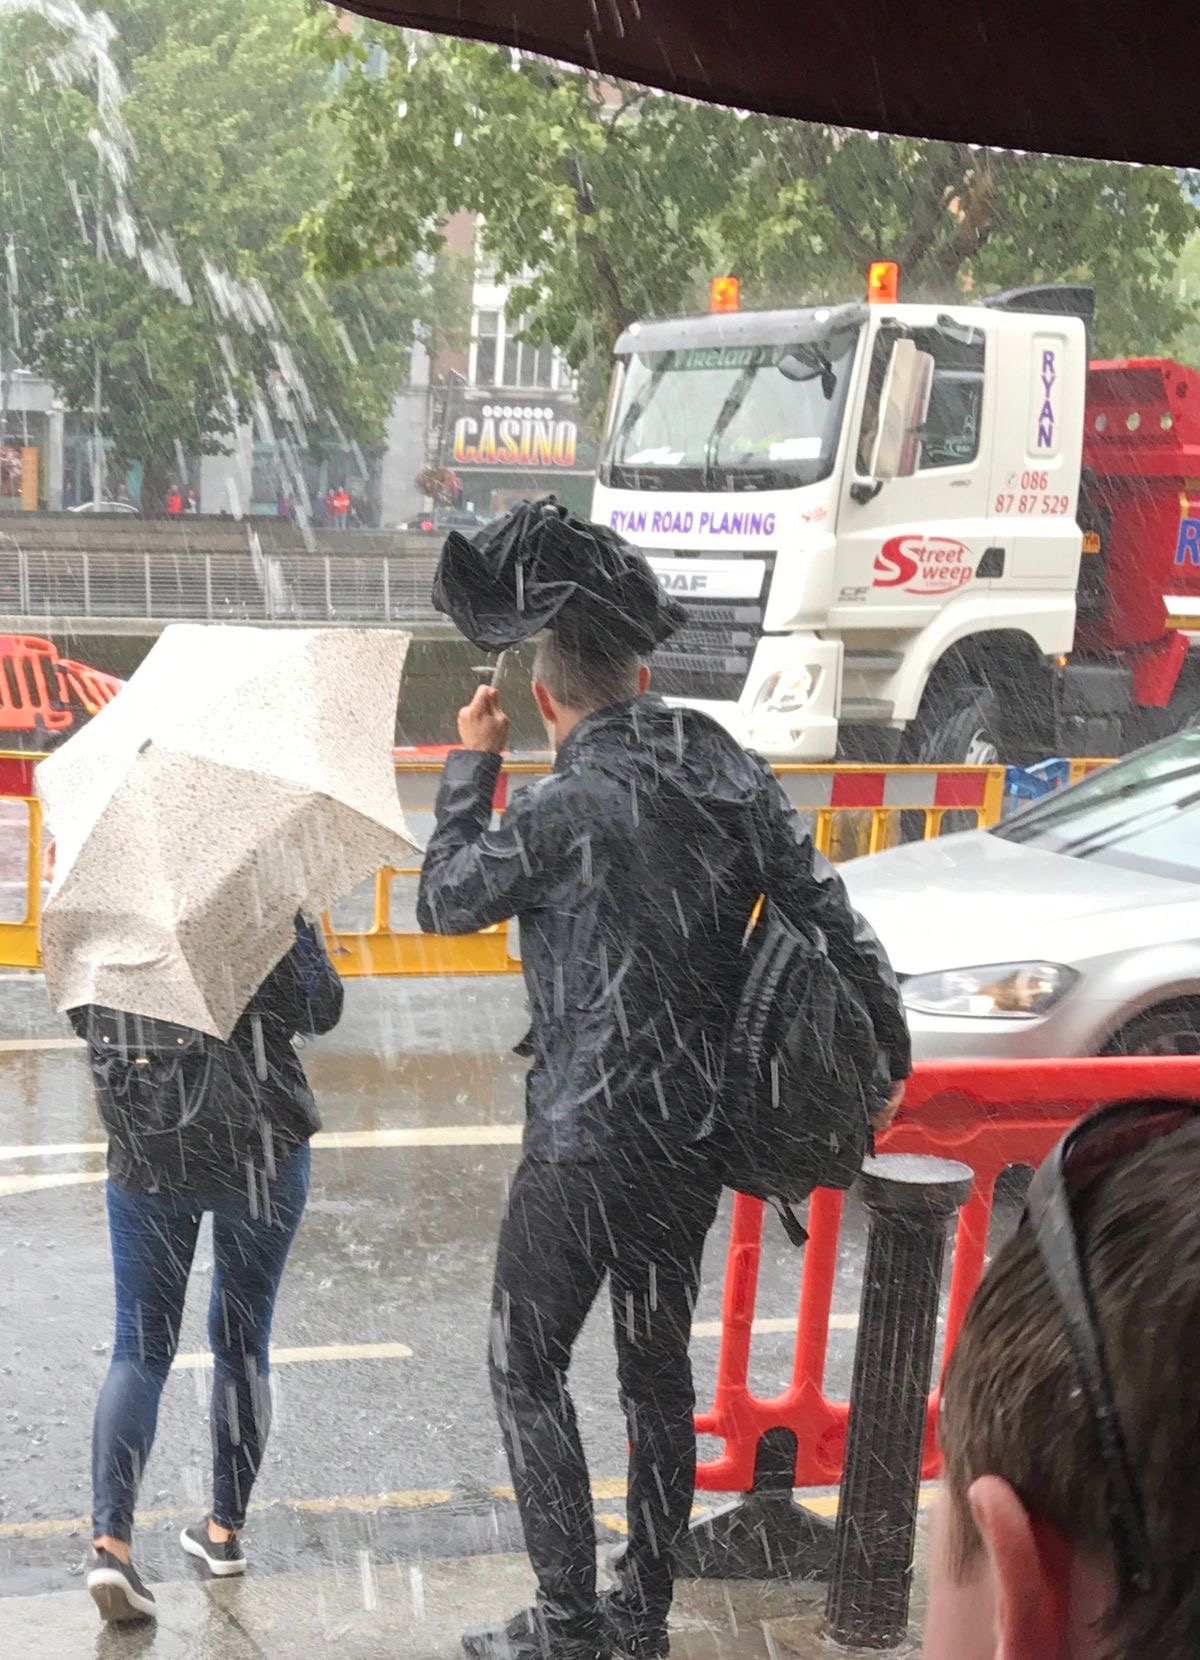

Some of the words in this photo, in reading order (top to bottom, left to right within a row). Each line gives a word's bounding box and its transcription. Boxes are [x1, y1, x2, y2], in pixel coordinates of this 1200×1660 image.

[1037, 350, 1056, 448] RYAN
[453, 416, 578, 467] CASINO
[1020, 471, 1049, 490] 086
[994, 494, 1014, 513] 87
[1018, 494, 1038, 514] 87
[1041, 495, 1069, 514] 529
[610, 510, 647, 532] RYAN
[651, 510, 694, 533] ROAD
[699, 511, 776, 536] PLANING
